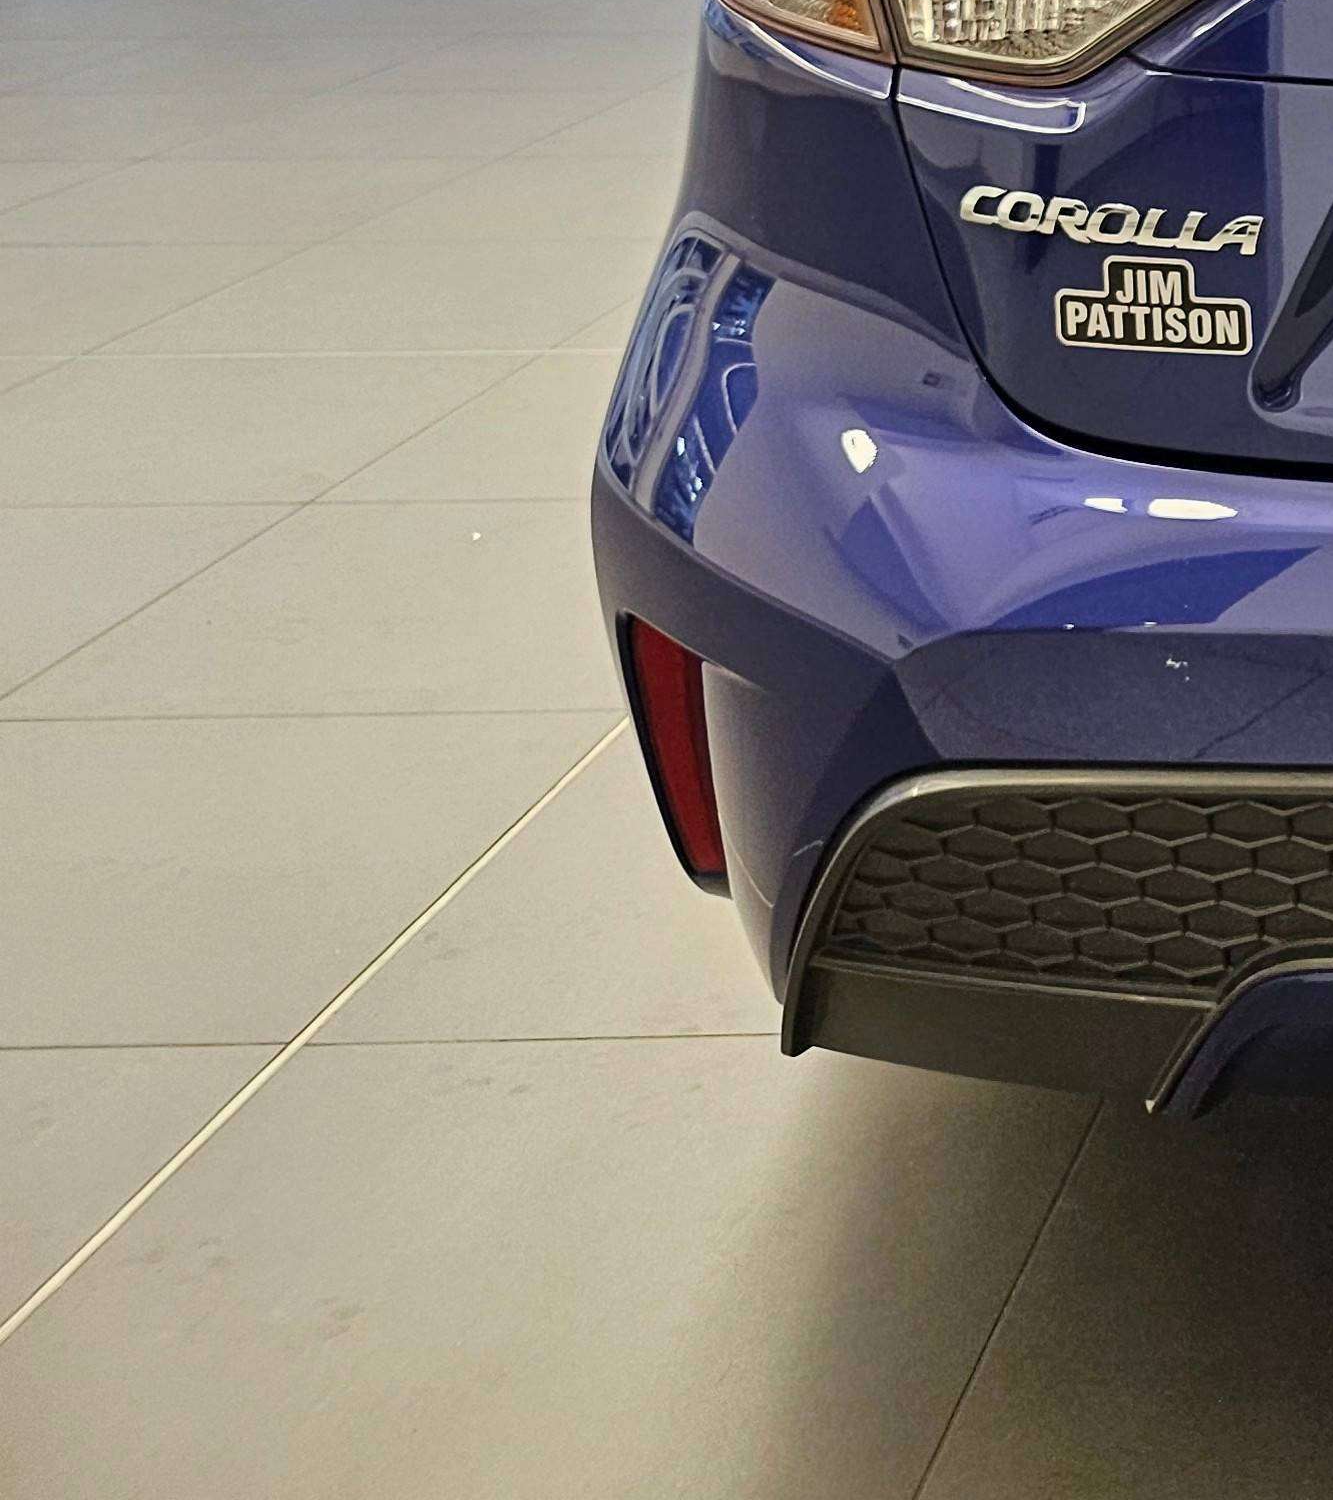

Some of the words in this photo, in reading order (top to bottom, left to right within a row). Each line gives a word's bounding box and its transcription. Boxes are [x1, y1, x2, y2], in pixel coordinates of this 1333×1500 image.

[960, 186, 1264, 255] COROLLA
[1115, 268, 1182, 306] JIM
[1065, 302, 1241, 345] PATTISON
